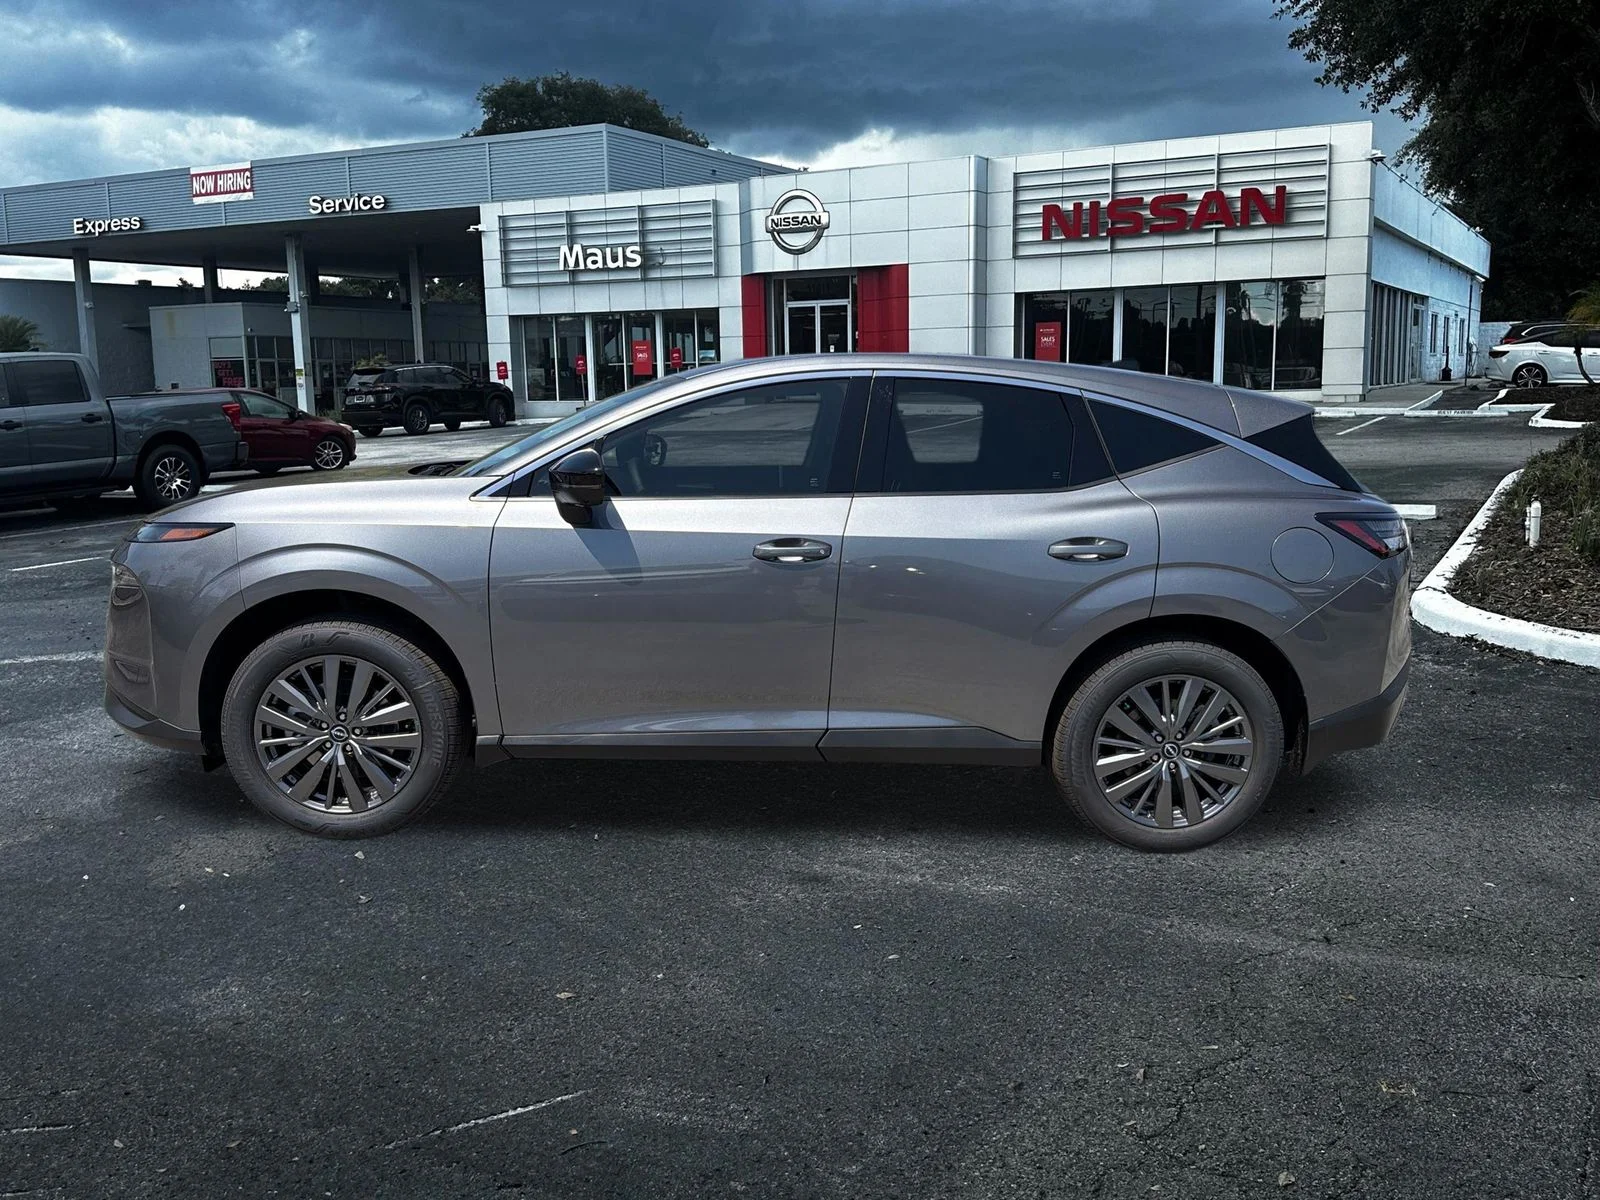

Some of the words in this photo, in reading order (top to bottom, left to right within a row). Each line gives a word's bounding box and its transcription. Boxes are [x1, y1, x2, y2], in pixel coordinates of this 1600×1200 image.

[192, 174, 215, 195] NOW
[217, 171, 251, 193] HIRING
[308, 192, 385, 215] Service
[1042, 185, 1287, 241] NISSAN
[73, 216, 141, 237] Express
[770, 214, 822, 228] NISSAN
[559, 243, 642, 271] Maus
